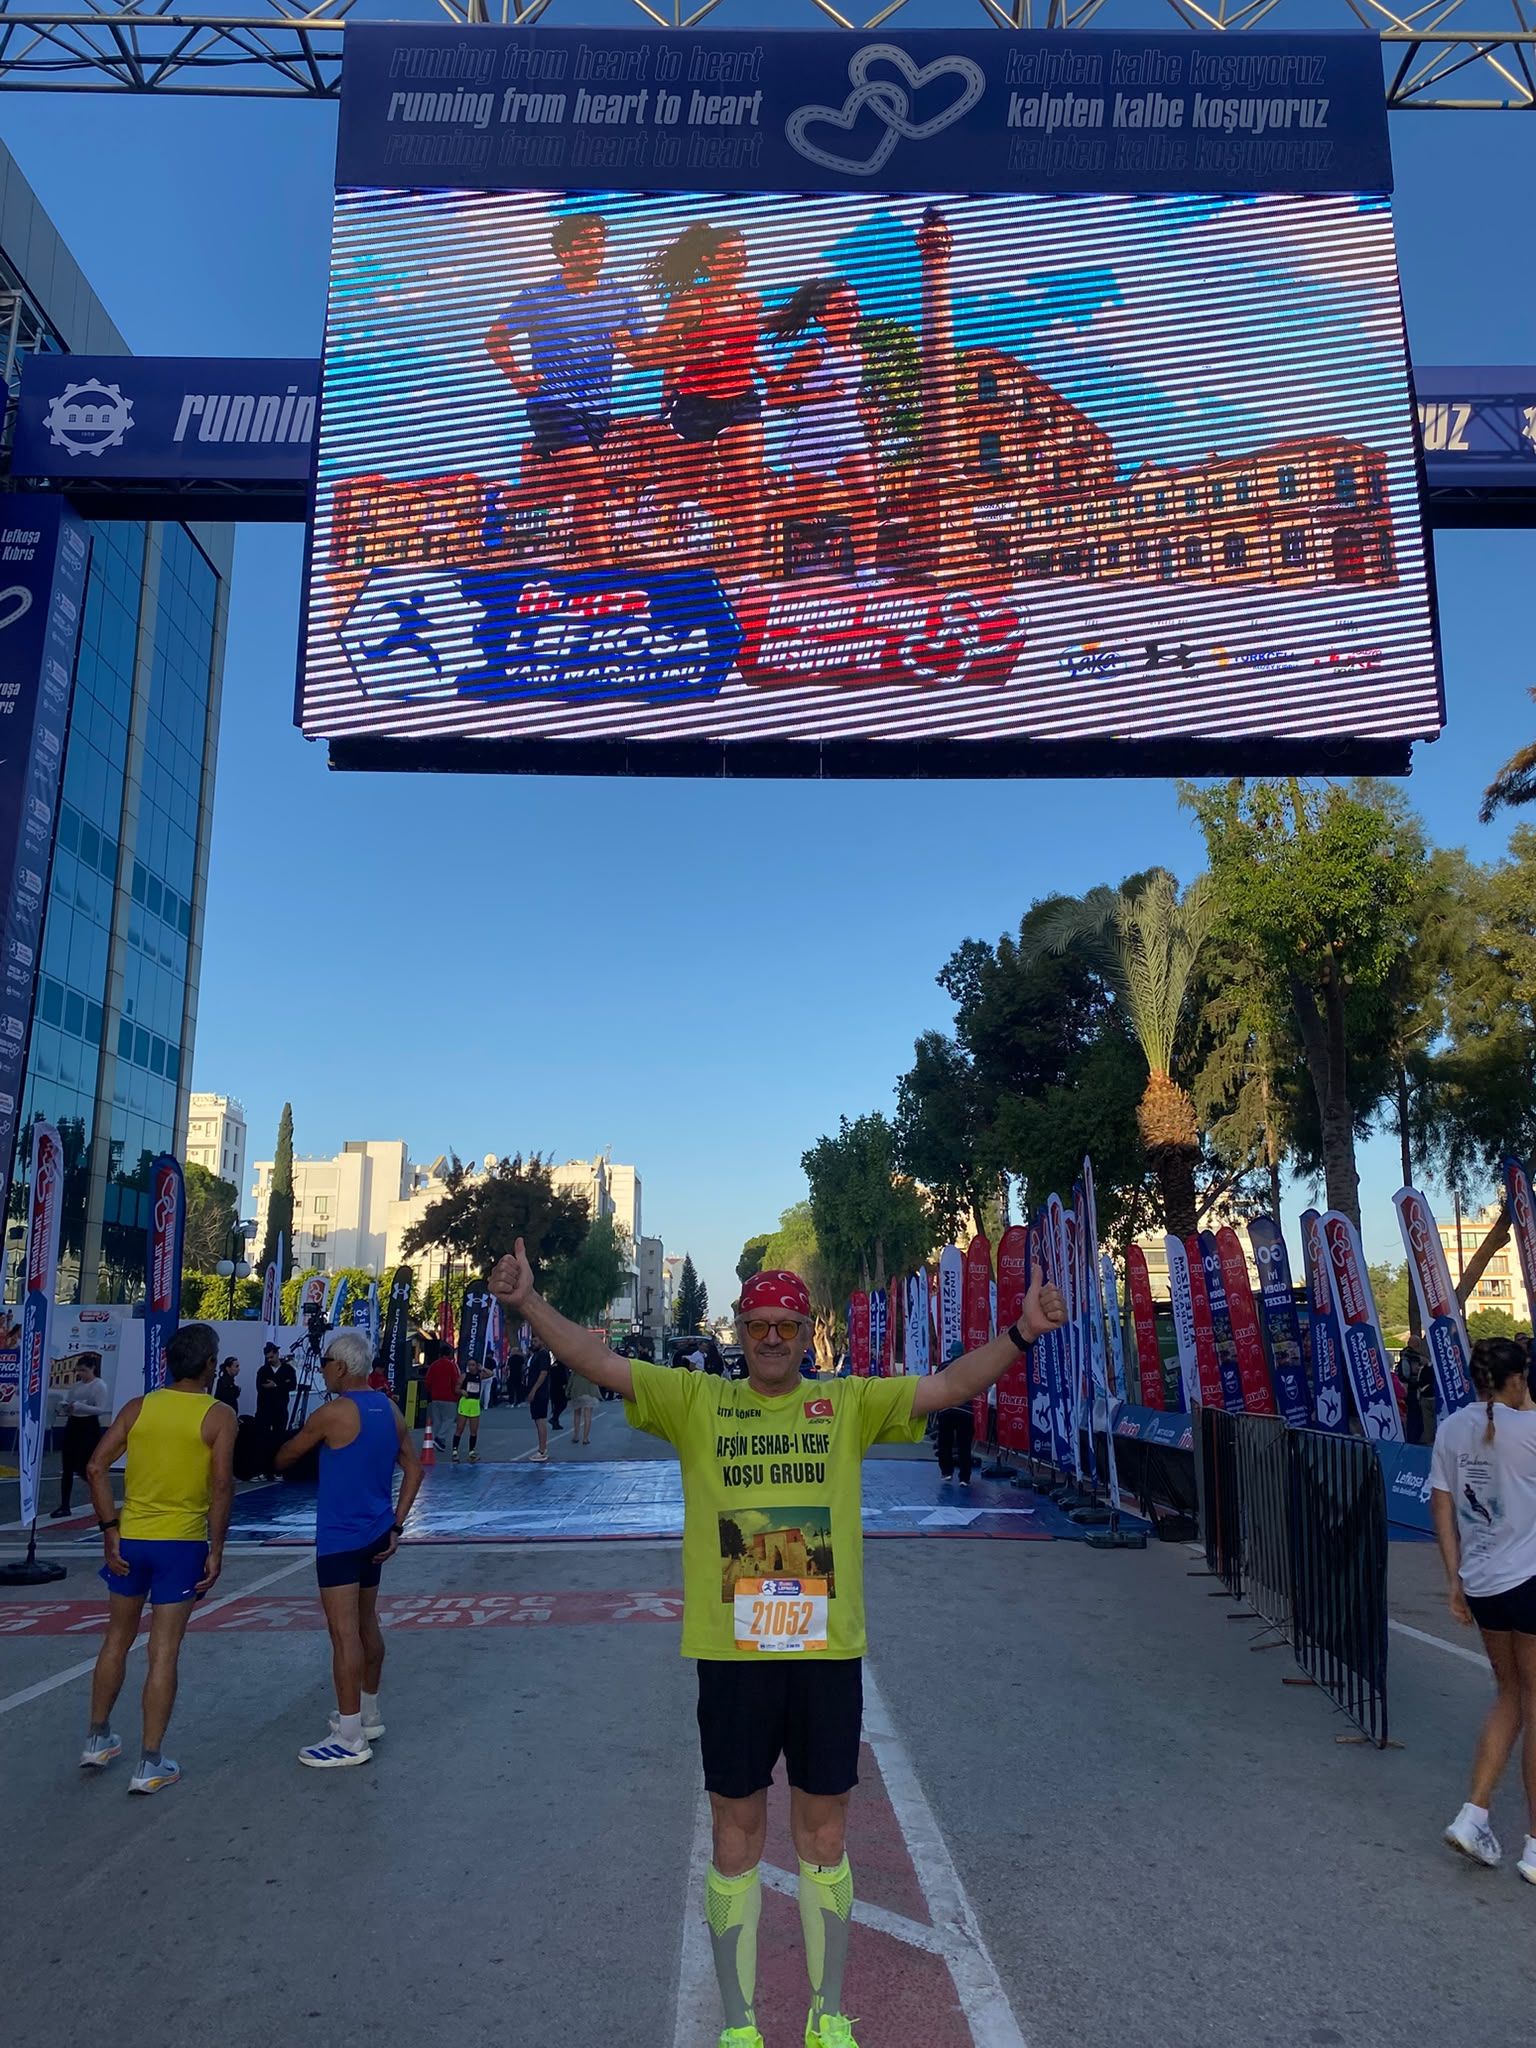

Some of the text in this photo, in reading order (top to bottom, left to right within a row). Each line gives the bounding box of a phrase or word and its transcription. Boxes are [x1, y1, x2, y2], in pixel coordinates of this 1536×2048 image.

[389, 42, 763, 84] running from heart to heart
[1005, 48, 1326, 91] kalpten kalbe koşuyoruz
[386, 87, 764, 129] running from heart to heart
[1006, 92, 1331, 135] kalpten kalbe koşuyoruz
[173, 386, 317, 443] runnin
[1, 528, 41, 546] Lefkoşa
[717, 1432, 829, 1459] AFŞİN ESHAB-I KEHF
[723, 1462, 825, 1488] KOŞU GRUBU
[391, 1595, 557, 1609] önce
[751, 1600, 814, 1636] 21052
